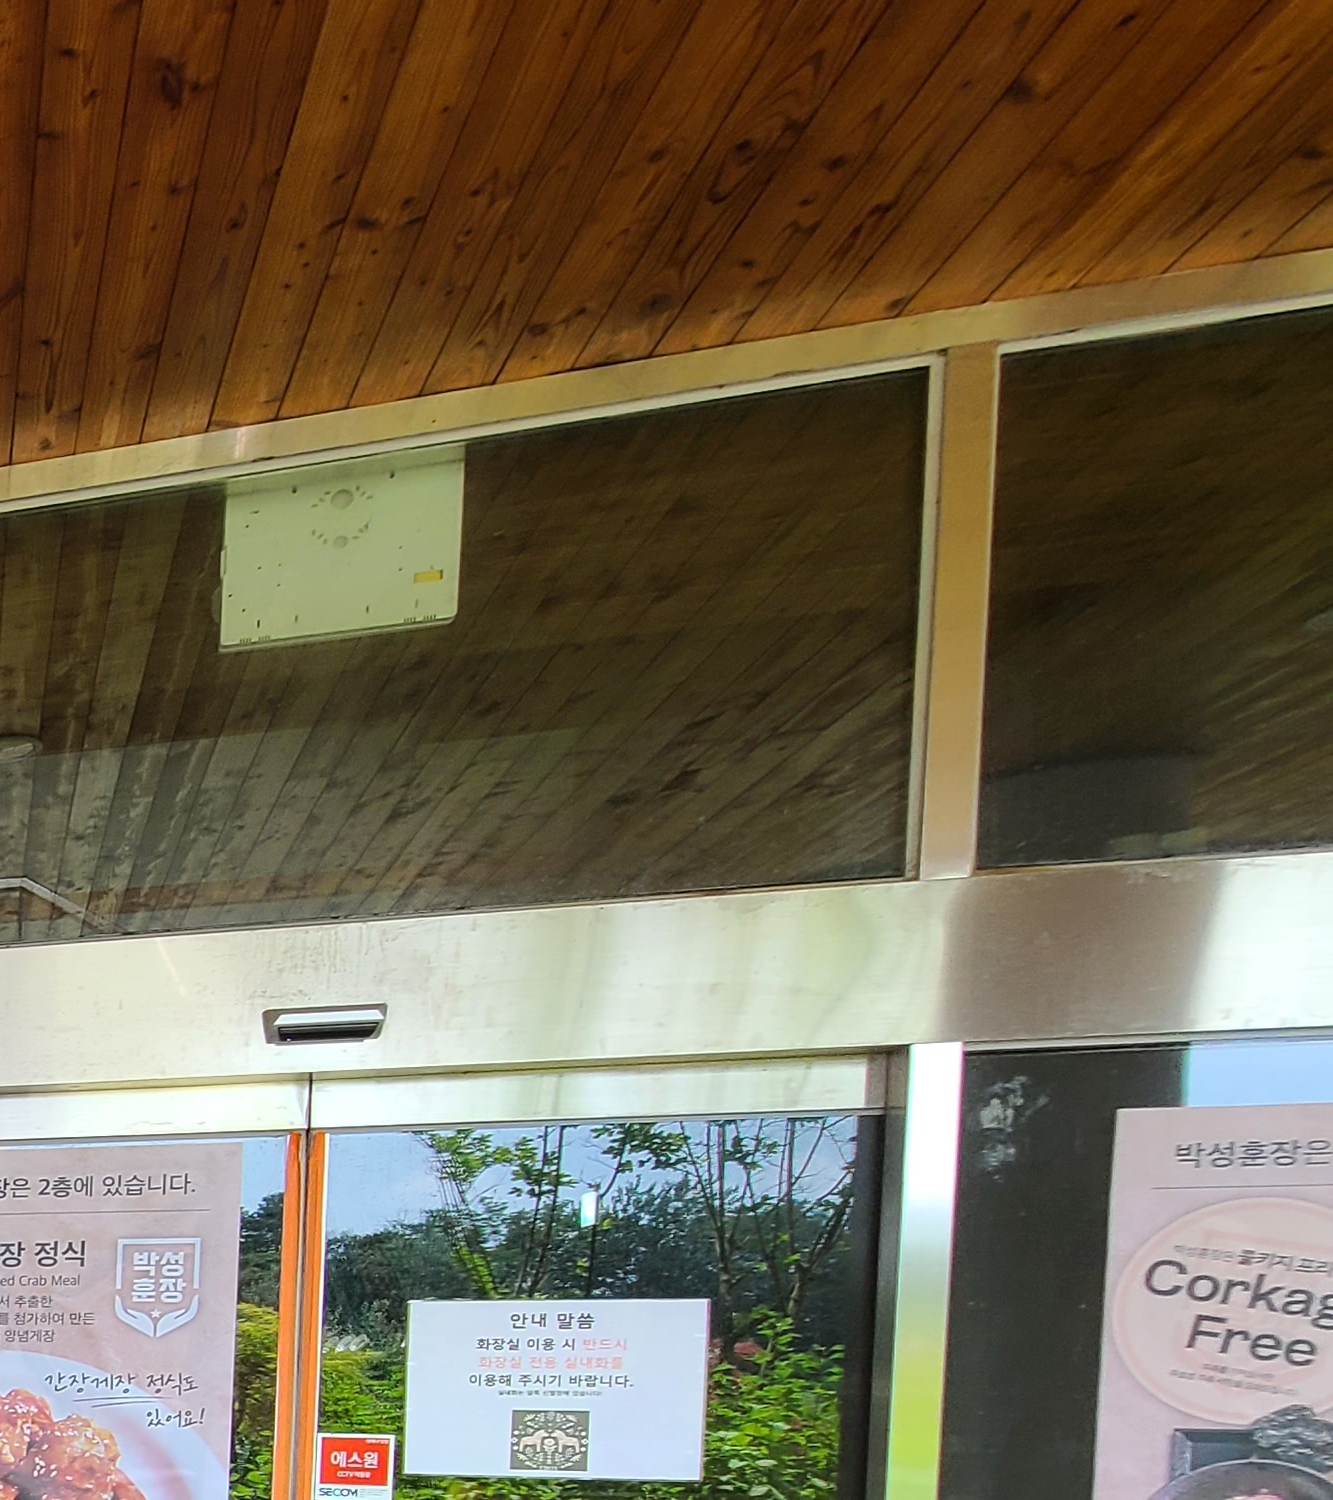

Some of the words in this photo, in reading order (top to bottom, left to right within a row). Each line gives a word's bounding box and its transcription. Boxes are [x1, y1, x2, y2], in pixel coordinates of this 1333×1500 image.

[1175, 1138, 1333, 1168] 박성훈장은
[37, 1175, 94, 1198] 2층에
[102, 1172, 196, 1197] 있습니다.
[34, 1240, 87, 1267] 정식
[133, 1251, 185, 1277] 박성
[19, 1275, 47, 1286] Crab
[51, 1274, 81, 1286] Meal
[132, 1278, 187, 1303] 훈장
[14, 1295, 53, 1308] 추출한
[13, 1312, 65, 1325] 첨가하여
[69, 1312, 96, 1325] 만든
[510, 1312, 547, 1329] 안내
[557, 1312, 595, 1330] 말씀
[4, 1329, 55, 1342] 양념게장
[476, 1338, 520, 1351] 화장실
[527, 1338, 555, 1351] 이용
[562, 1338, 575, 1351] 시
[583, 1338, 627, 1350] 반드시
[1185, 1314, 1318, 1367] Free
[478, 1356, 522, 1369] 화장실
[529, 1356, 557, 1369] 전용
[564, 1356, 623, 1370] 실내화를
[44, 1371, 137, 1393] 간장게장
[146, 1372, 199, 1396] 정식도
[469, 1374, 512, 1387] 이용해
[518, 1374, 562, 1387] 주시기
[569, 1374, 634, 1388] 바랍니다.
[146, 1407, 206, 1428] 있어요!
[330, 1451, 379, 1469] 에스원
[319, 1487, 358, 1497] SECOM
